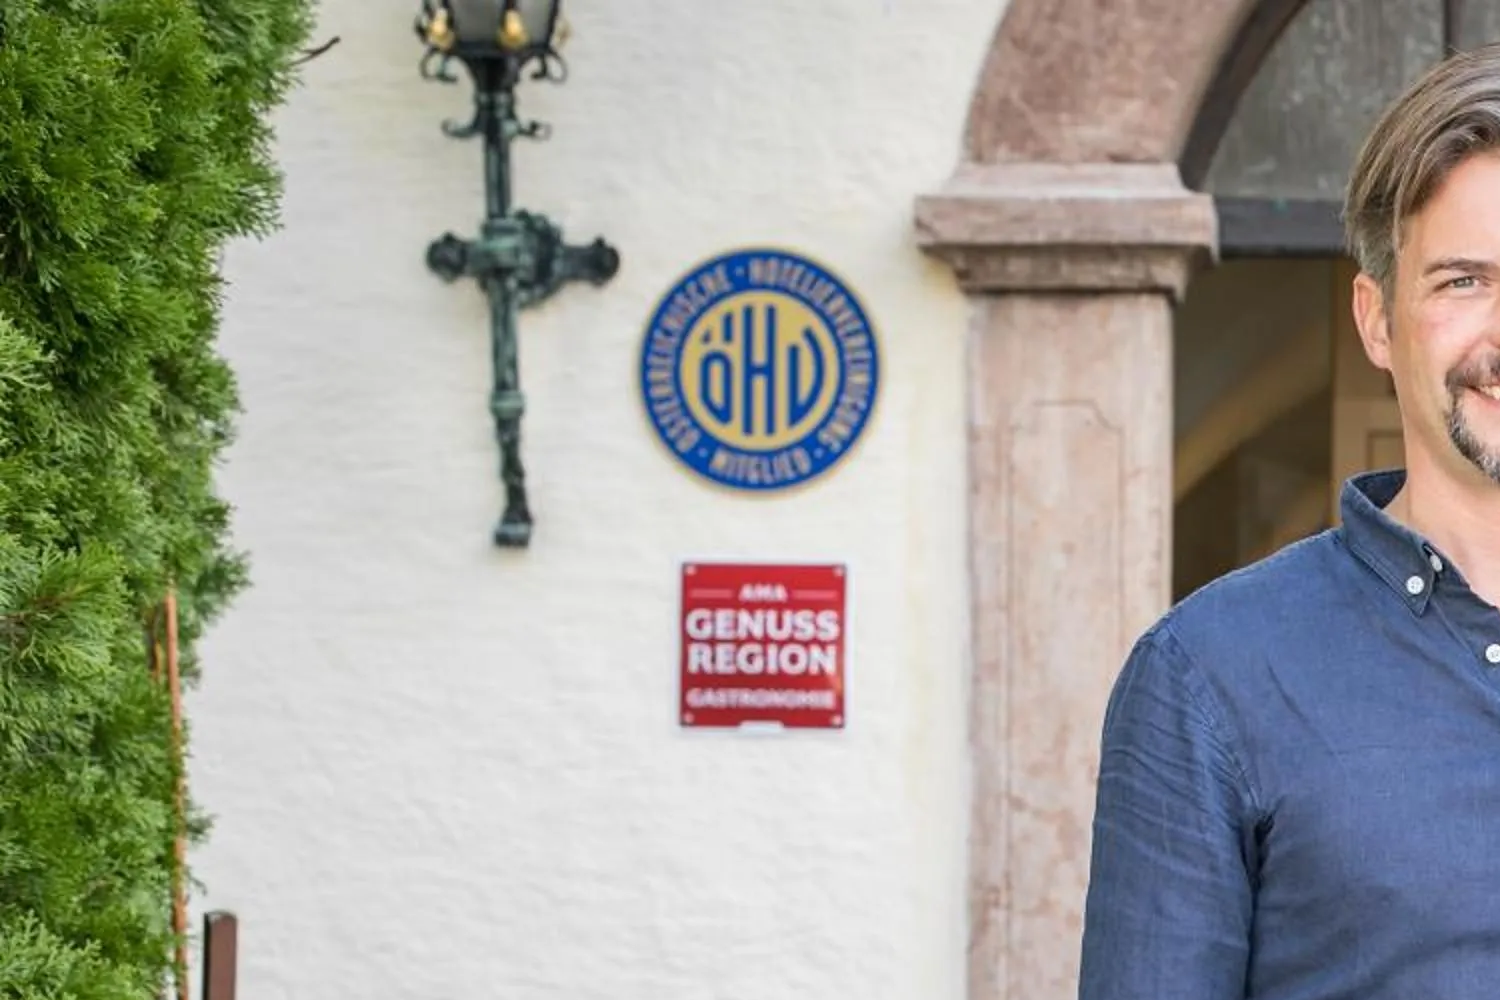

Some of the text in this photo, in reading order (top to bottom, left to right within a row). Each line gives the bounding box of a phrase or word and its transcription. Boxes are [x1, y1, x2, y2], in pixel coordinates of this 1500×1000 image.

[699, 305, 825, 437] ÖHV
[709, 446, 812, 485] MITGLIED
[738, 583, 788, 602] AMA
[685, 608, 840, 641] GENUSS
[687, 642, 837, 675] REGION
